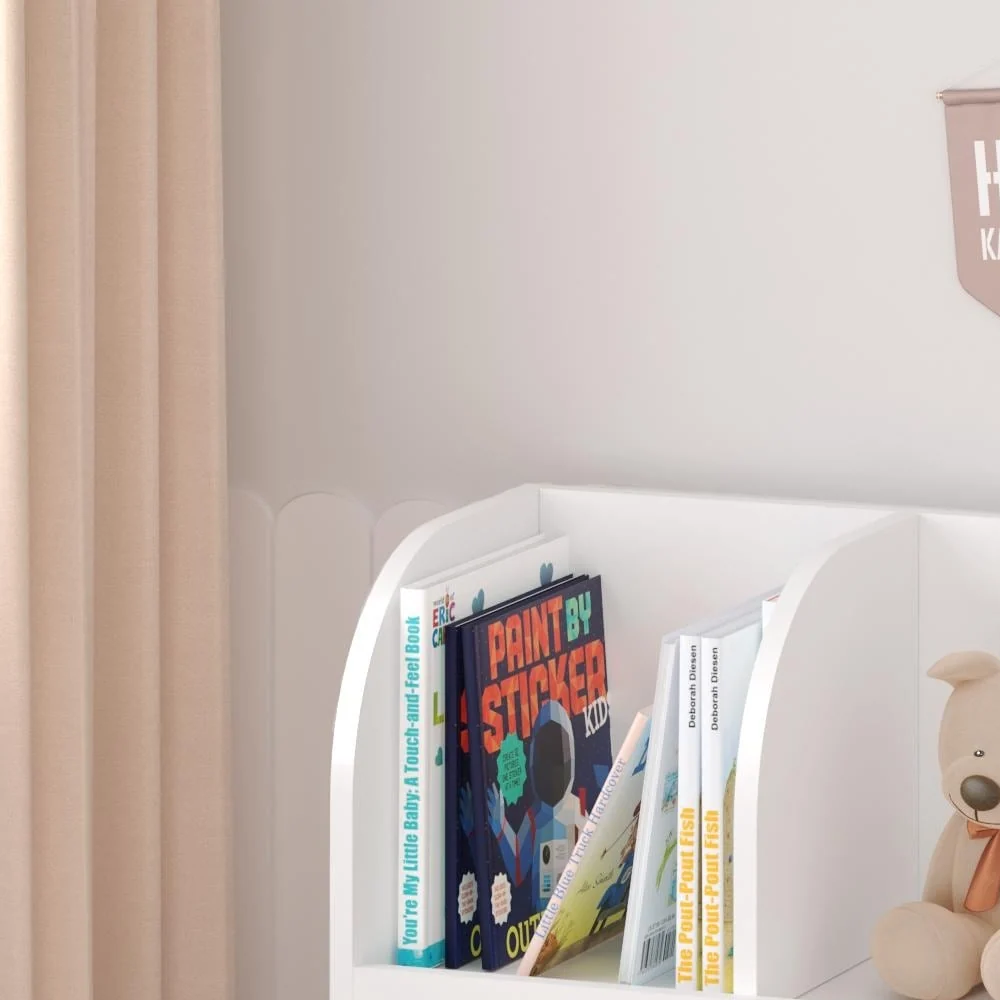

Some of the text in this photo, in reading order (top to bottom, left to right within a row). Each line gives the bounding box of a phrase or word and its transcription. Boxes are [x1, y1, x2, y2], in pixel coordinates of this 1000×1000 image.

[488, 591, 592, 680] PAINT BY
[688, 645, 697, 728] Deborah Diesen
[710, 647, 719, 731] Deborah Diesen
[482, 639, 607, 754] STICKER
[403, 616, 420, 945] You're My Little Baby: A Touch-and-Feel Book
[535, 758, 627, 940] Little Blue Truck Hardcover
[677, 807, 695, 983] The Pout-Pout Fish
[704, 809, 719, 986] The Pout-Pout Fish
[506, 911, 546, 958] OUT
